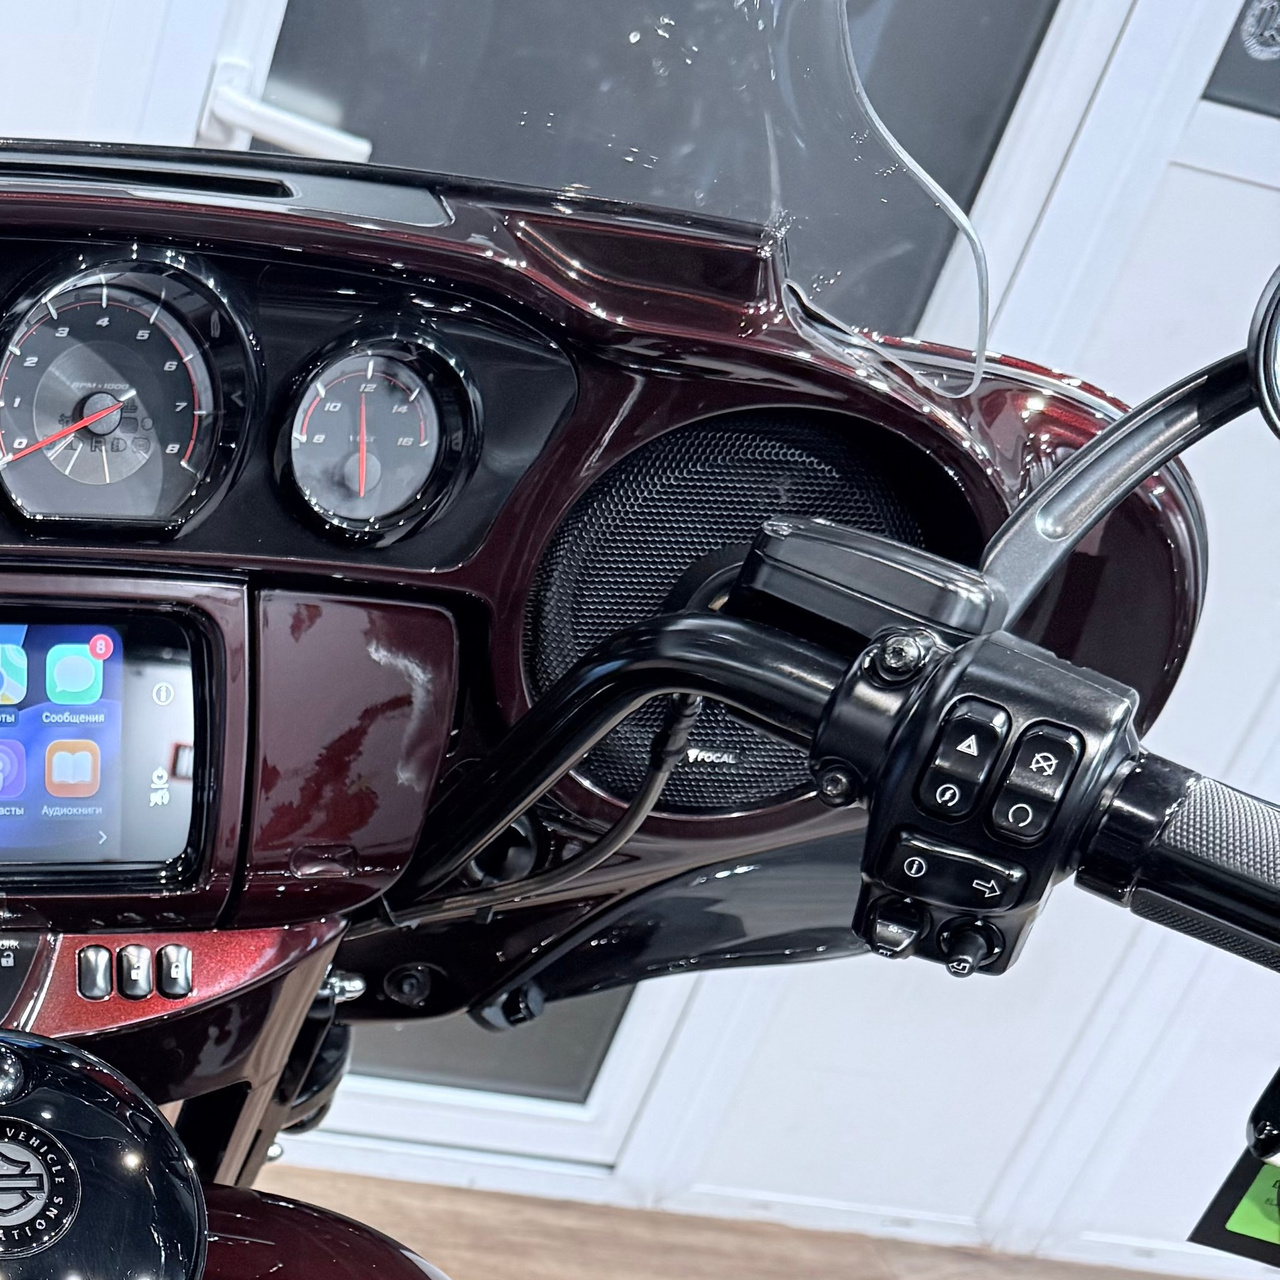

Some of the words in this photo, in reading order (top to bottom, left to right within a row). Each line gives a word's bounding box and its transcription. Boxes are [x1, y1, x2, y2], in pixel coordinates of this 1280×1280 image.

[96, 317, 110, 328] 4
[55, 327, 70, 338] 3
[136, 330, 151, 340] 5
[23, 357, 39, 367] 2
[163, 361, 178, 372] 6
[359, 383, 377, 392] 12
[13, 398, 21, 408] 1
[175, 402, 188, 412] 7
[324, 402, 342, 412] 10
[391, 405, 409, 414] 14
[312, 434, 326, 443] 8
[397, 437, 414, 446] 16
[12, 439, 28, 449] 0
[165, 444, 180, 454] 8
[96, 640, 106, 654] 8
[42, 712, 105, 724] Сообщения
[697, 750, 737, 764] FOCAL
[41, 805, 103, 817] Аудиокниги
[6, 1127, 65, 1185] VEHICLE
